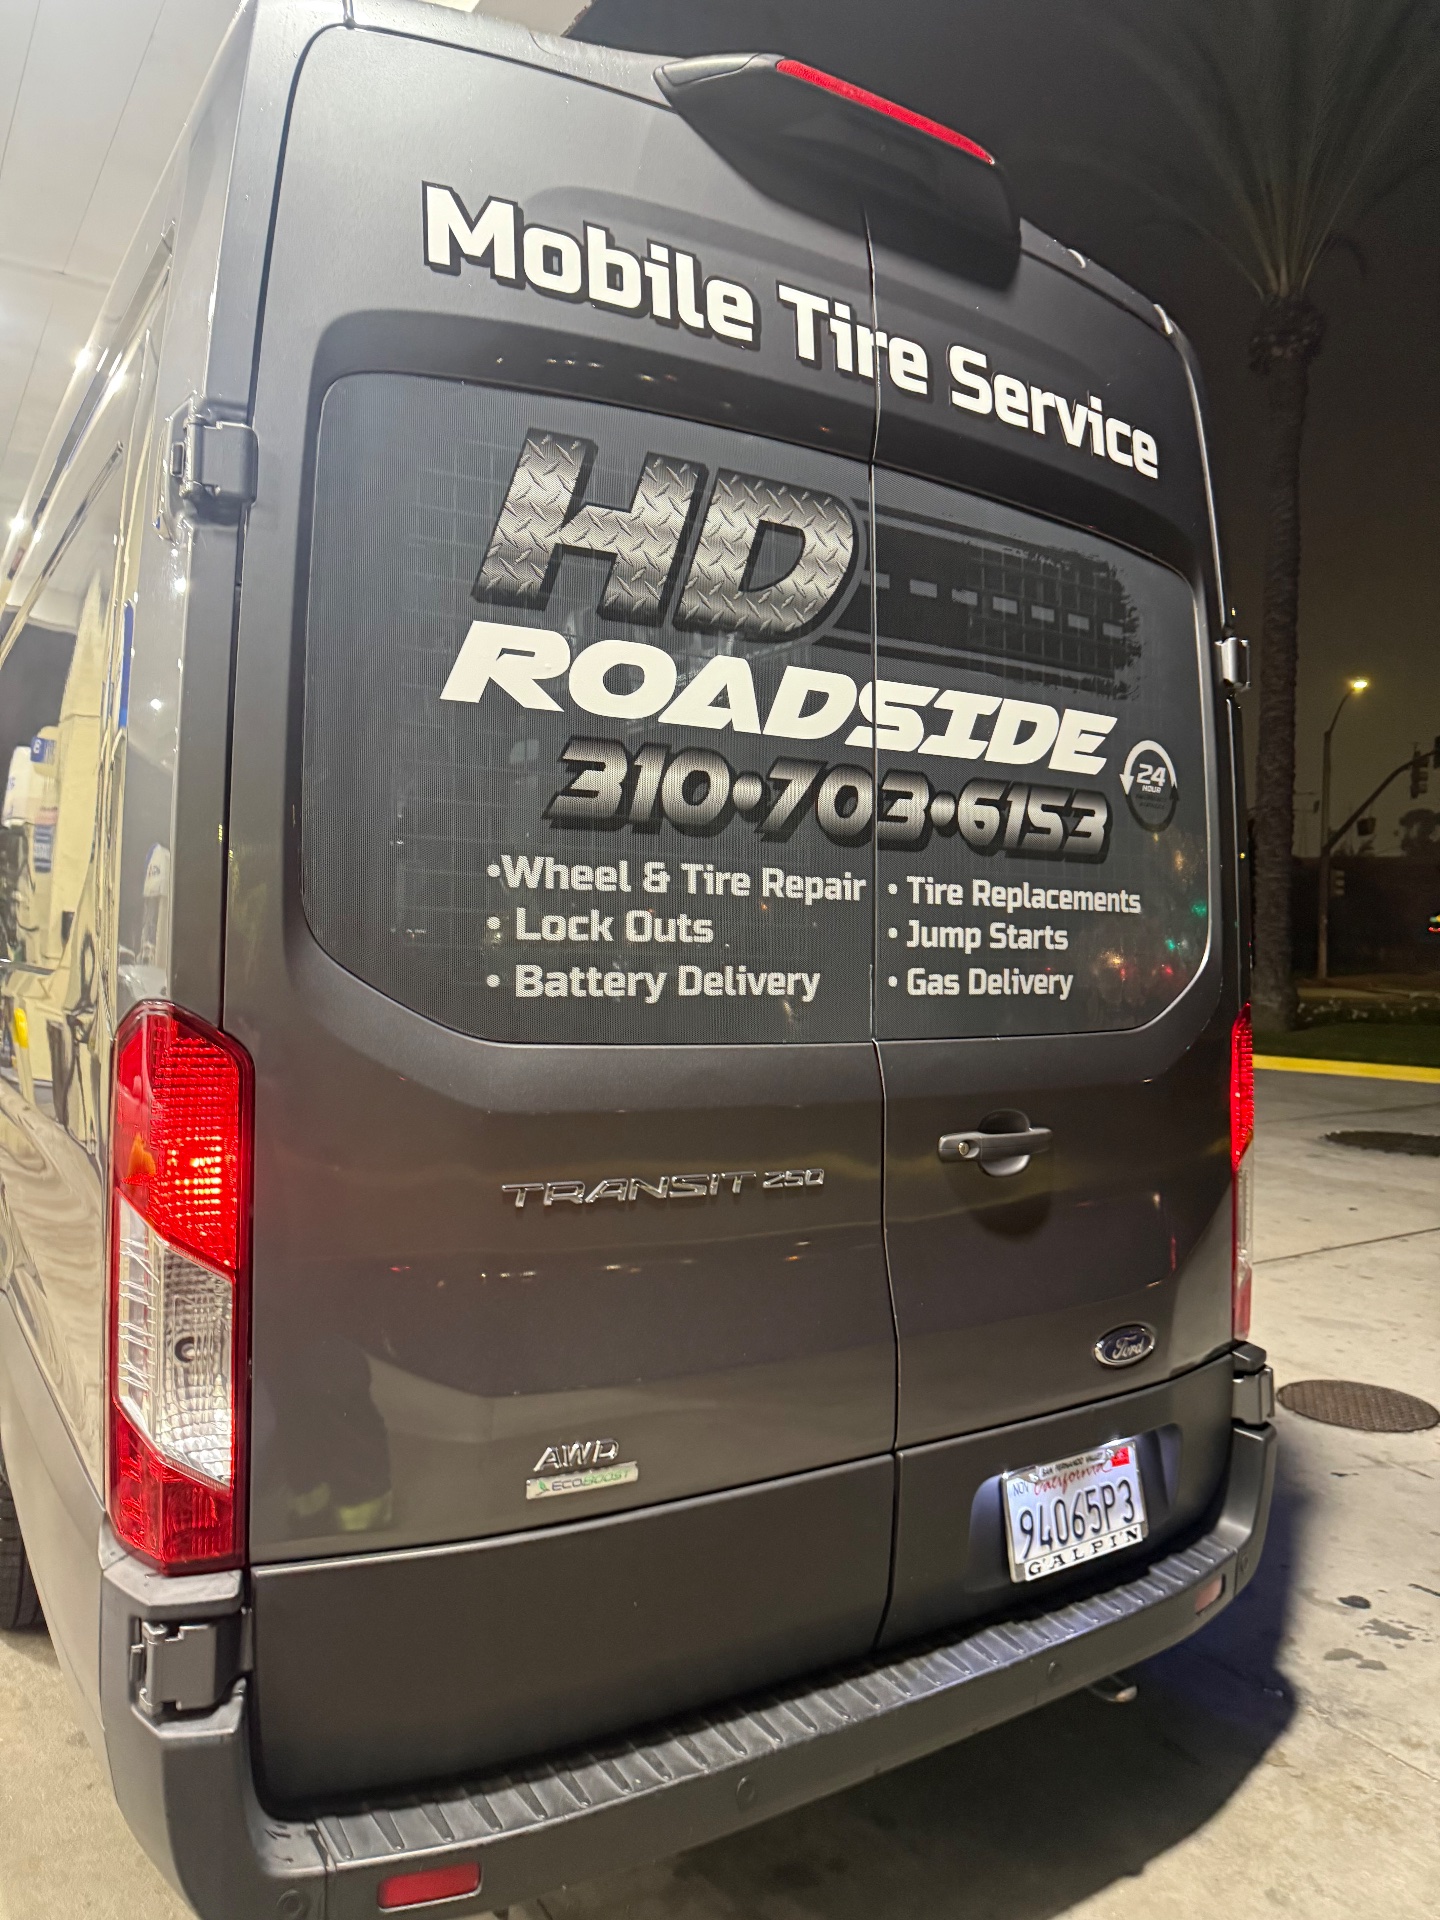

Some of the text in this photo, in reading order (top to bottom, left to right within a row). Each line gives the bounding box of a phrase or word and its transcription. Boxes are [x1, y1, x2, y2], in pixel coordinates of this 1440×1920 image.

[423, 181, 1160, 481] Mobile Tire Service
[472, 427, 860, 642] HD
[440, 620, 1118, 776] ROADSIDE
[1136, 763, 1166, 787] 24
[642, 862, 671, 893] &
[681, 863, 751, 897] Tire
[761, 867, 867, 905] Repair
[906, 875, 1142, 914] Tire Replacements
[515, 906, 715, 944] Lock Outs
[906, 919, 1070, 955] Jump Starts
[514, 964, 822, 1005] Battery Delivery
[906, 967, 1074, 1001] Gas Delivery
[501, 1168, 825, 1208] TRANSIT 250
[1111, 1334, 1146, 1360] Ford
[533, 1438, 620, 1472] AWD
[1033, 1461, 1112, 1496] California
[1019, 1479, 1136, 1559] 94065P3
[1028, 1527, 1140, 1577] GALPIN
